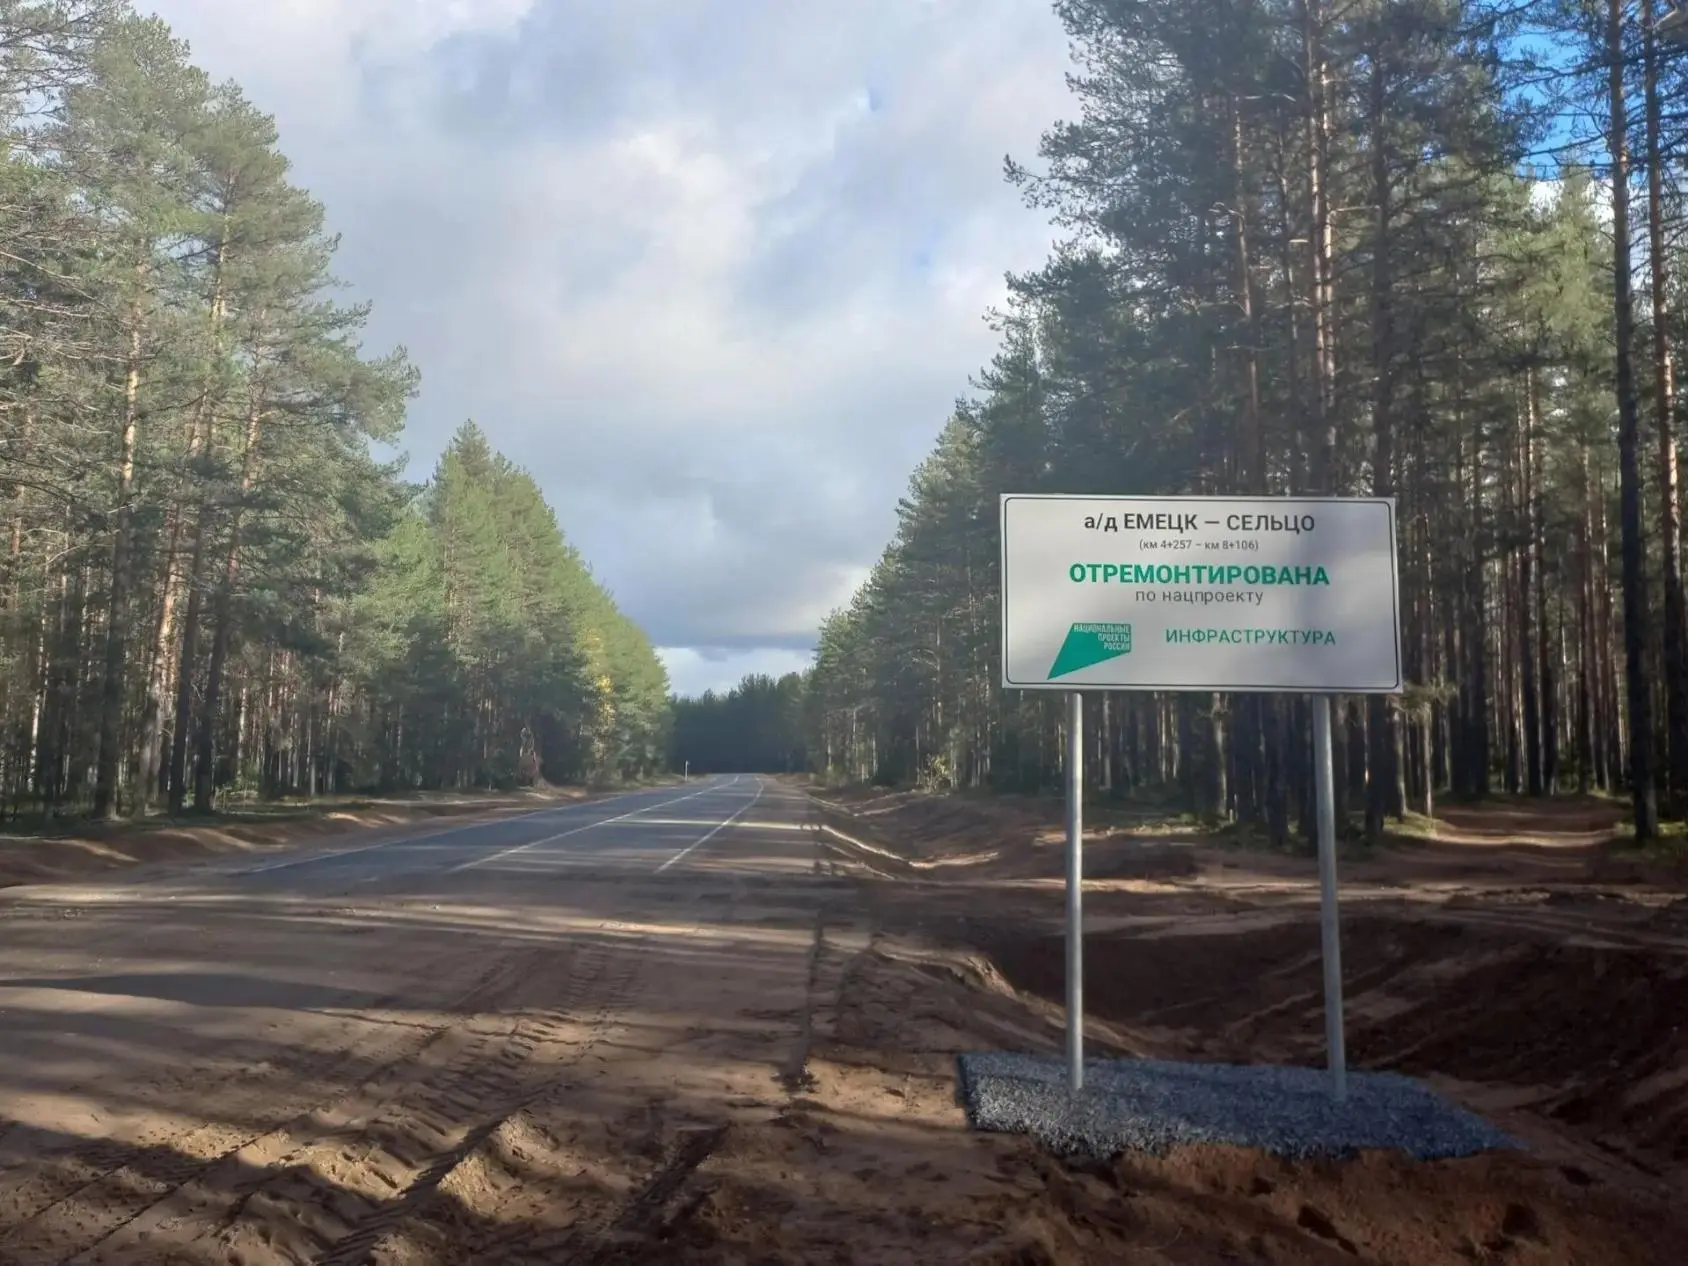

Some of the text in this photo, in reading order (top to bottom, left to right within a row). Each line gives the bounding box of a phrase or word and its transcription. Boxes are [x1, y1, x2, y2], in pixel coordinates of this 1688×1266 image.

[1084, 513, 1118, 532] а/д
[1124, 513, 1198, 533] ЕМЕЦК
[1226, 514, 1315, 534] СЕЛЬЦО
[1139, 538, 1158, 551] (км
[1160, 539, 1193, 550] 4+257
[1204, 541, 1219, 551] км
[1222, 539, 1259, 551] 8+106)
[1069, 563, 1330, 586] ОТРЕМОНТИРОВАНА
[1135, 590, 1264, 606] по нацпроекту
[1165, 628, 1336, 646] ИНФРАСТРУКТУРА
